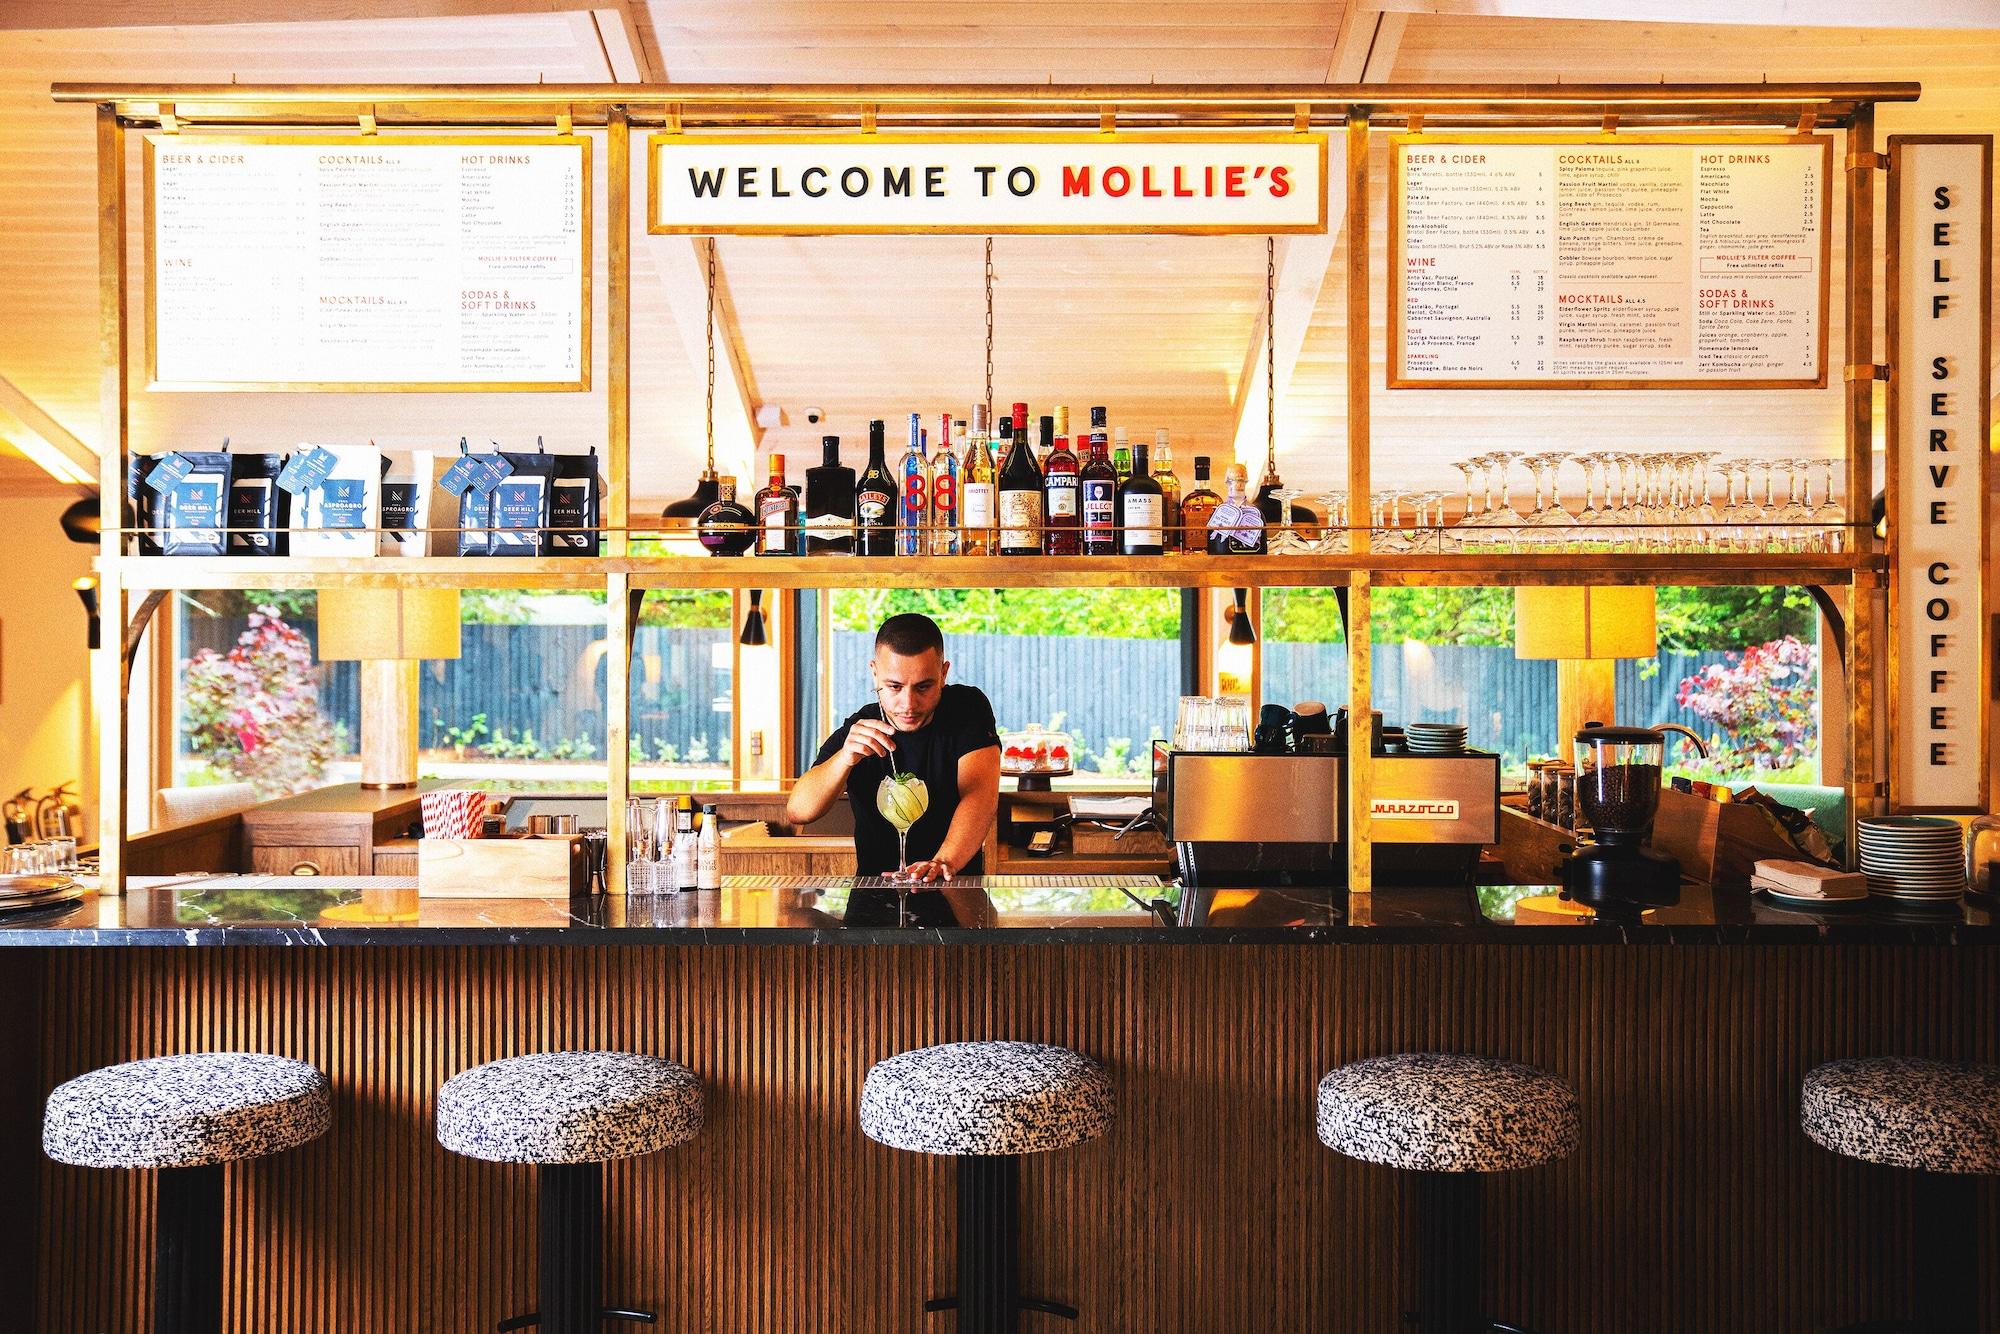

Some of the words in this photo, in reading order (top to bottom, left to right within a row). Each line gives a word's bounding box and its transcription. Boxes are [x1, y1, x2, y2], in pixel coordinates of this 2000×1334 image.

[319, 156, 383, 164] COCKTAILS
[688, 167, 945, 198] WELCOME
[974, 167, 1036, 198] TO
[1932, 186, 1950, 319] SELF
[1929, 356, 1949, 524] SERVE
[1926, 562, 1950, 765] COFFEE
